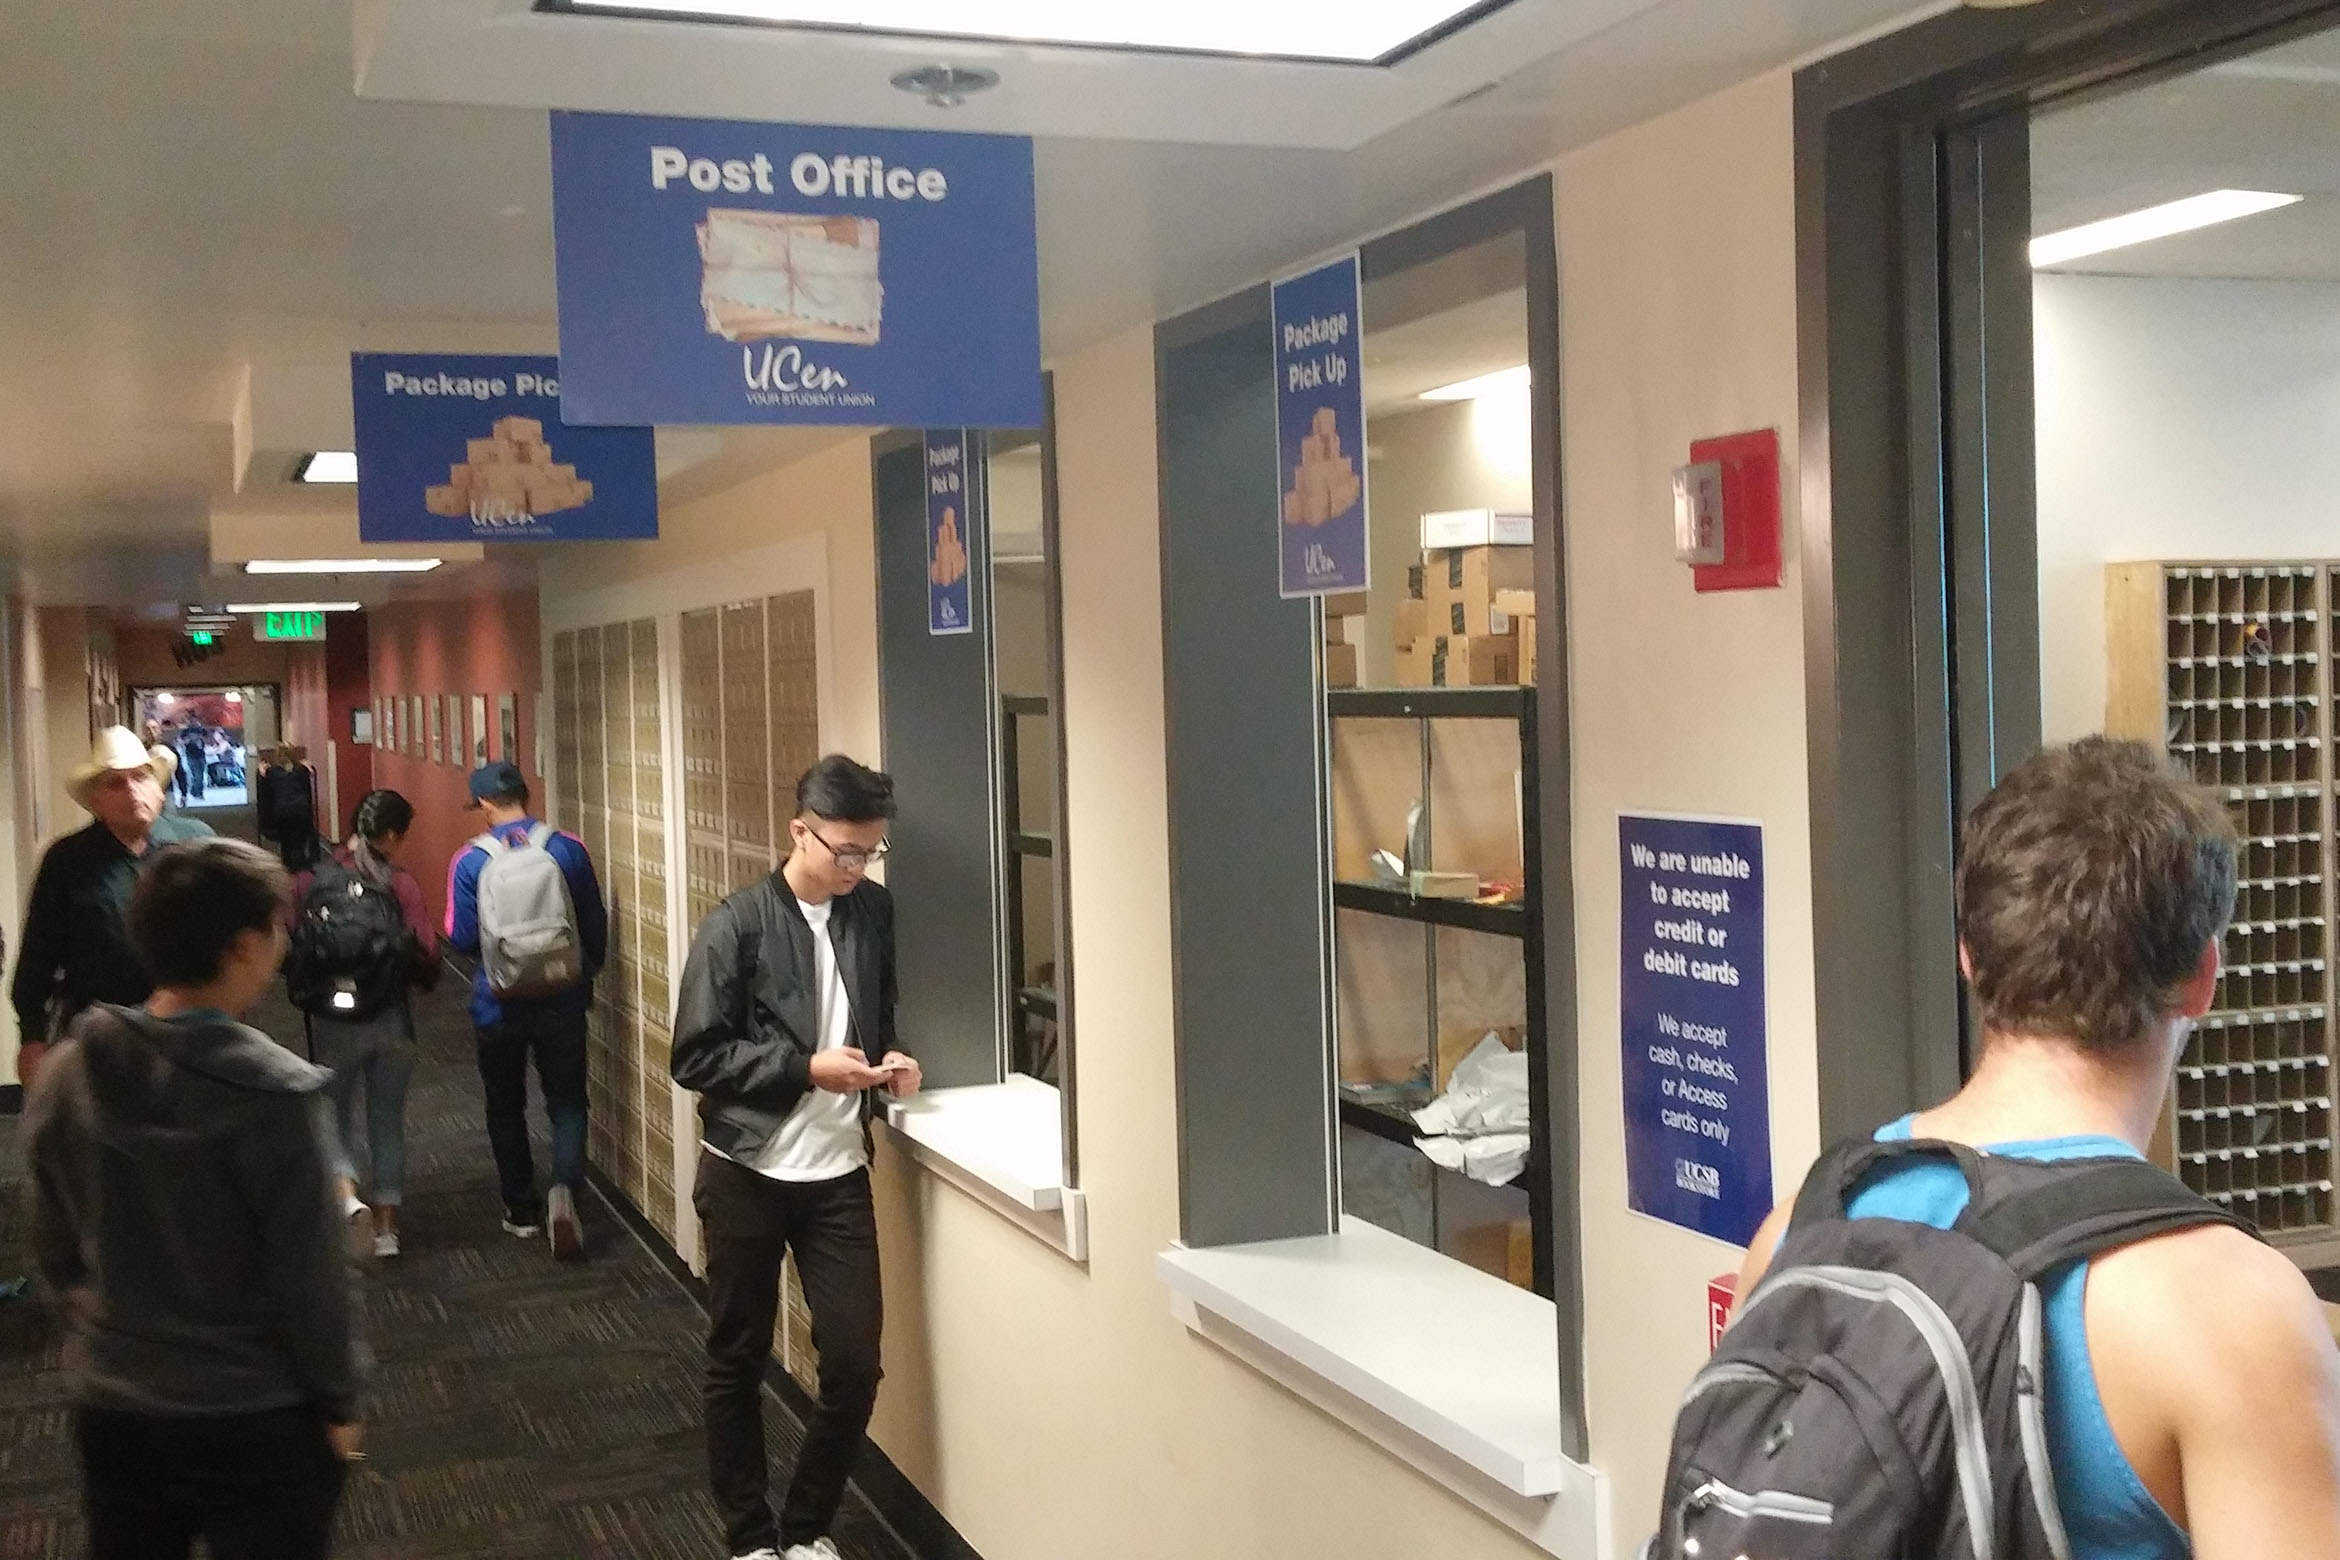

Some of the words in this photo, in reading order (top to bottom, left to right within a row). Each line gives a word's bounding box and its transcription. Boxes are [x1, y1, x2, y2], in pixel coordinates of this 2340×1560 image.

[650, 145, 775, 195] Post
[790, 152, 948, 202] Office
[1284, 312, 1348, 352] Package
[384, 371, 508, 401] Package
[515, 372, 560, 398] Pic
[743, 343, 849, 392] UCen
[1289, 358, 1323, 393] Pick
[1325, 352, 1347, 386] Up
[745, 392, 780, 406] YOUR
[781, 392, 836, 407] STUDENT
[837, 392, 877, 408] UNION
[265, 611, 319, 638] EXIT
[1630, 843, 1657, 870] We
[1659, 851, 1687, 873] are
[1690, 852, 1751, 880] unable
[1650, 880, 1668, 905] to
[1671, 888, 1731, 916] accept
[1654, 918, 1705, 945] credit
[1707, 927, 1728, 949] or
[1643, 948, 1688, 977] debit
[1690, 959, 1741, 987] cards
[1657, 1011, 1680, 1038] We
[1681, 1021, 1729, 1050] accept
[1648, 1045, 1684, 1072] cash,
[1686, 1050, 1739, 1086] checks,
[1661, 1078, 1677, 1097] or
[1677, 1078, 1728, 1111] Access
[1661, 1108, 1700, 1134] cards
[1700, 1117, 1731, 1147] only
[1683, 1159, 1720, 1187] UCSB
